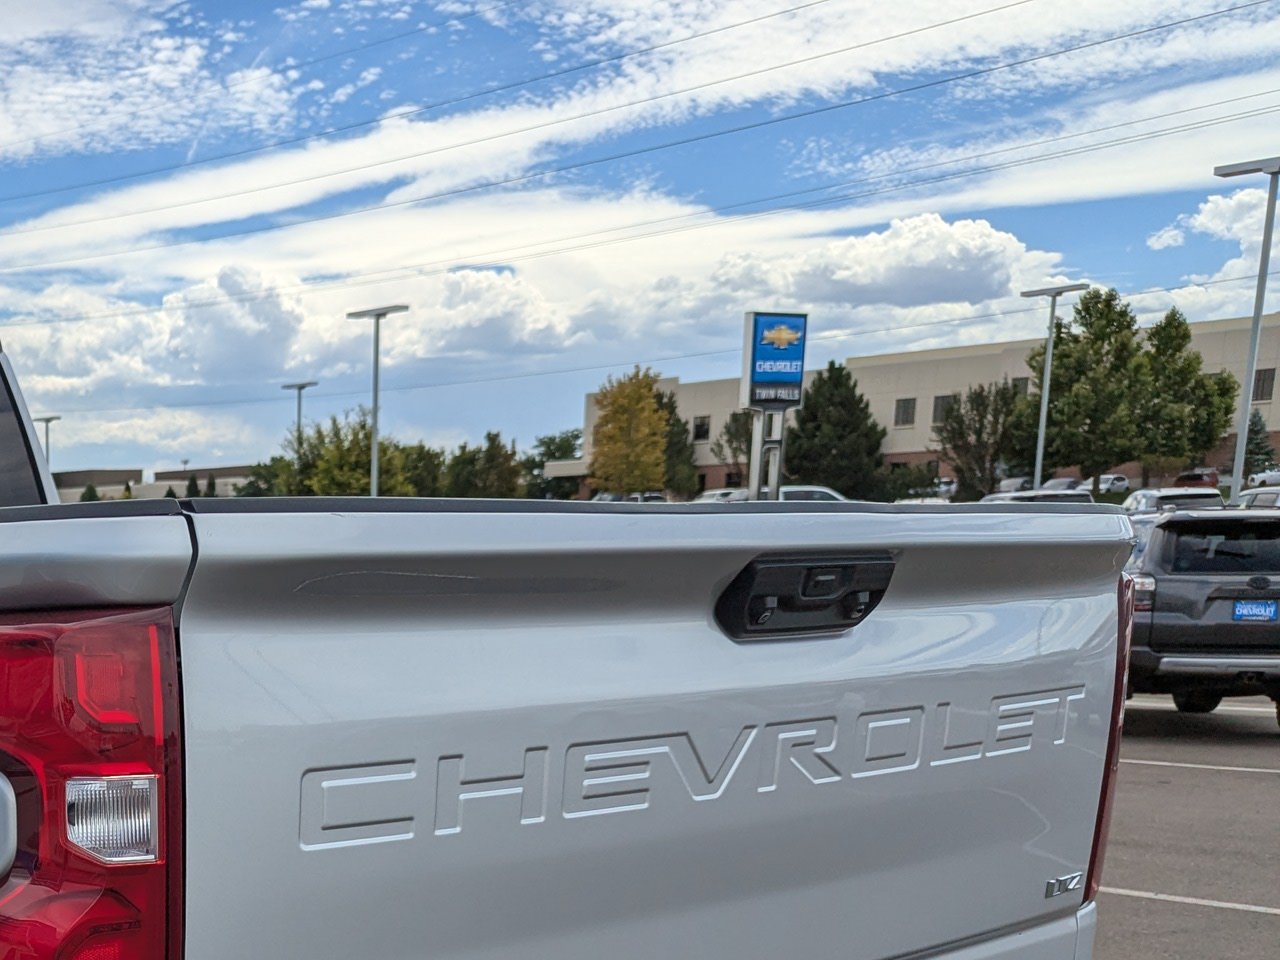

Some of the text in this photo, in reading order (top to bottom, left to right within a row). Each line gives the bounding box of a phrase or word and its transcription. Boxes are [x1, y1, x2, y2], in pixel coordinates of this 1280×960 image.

[756, 361, 802, 373] CHEVROLET
[755, 388, 800, 400] TWIN FALLS
[299, 683, 1087, 852] CHEVROLET
[1044, 871, 1084, 899] LTZ
